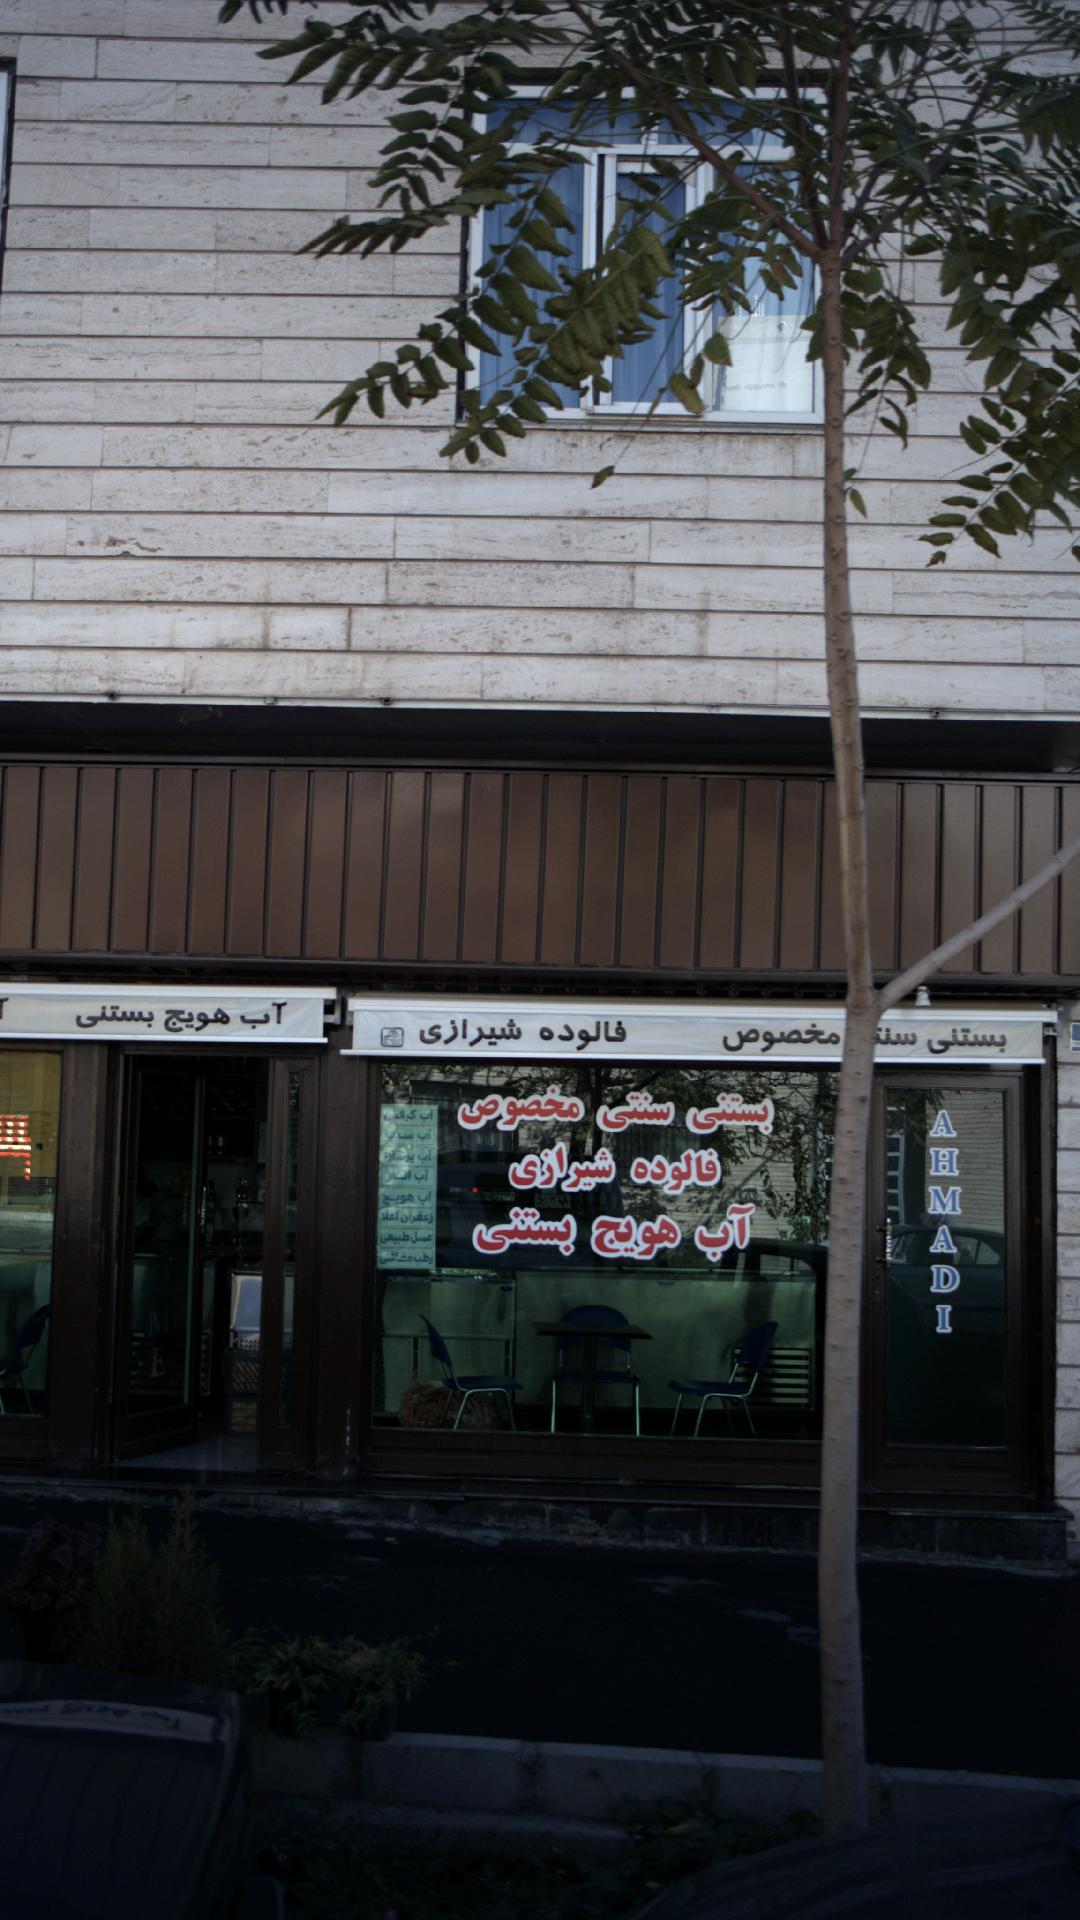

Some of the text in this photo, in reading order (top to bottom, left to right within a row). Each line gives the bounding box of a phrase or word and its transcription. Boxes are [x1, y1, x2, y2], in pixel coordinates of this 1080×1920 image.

[75, 1002, 288, 1032] آب هویج بستنی
[419, 1019, 627, 1051] فالوده شیرازی
[722, 1023, 1008, 1054] بستنی سنت مخصوص
[420, 1109, 433, 1122] آب
[459, 1086, 773, 1134] بستنی سنتی مخصوص
[414, 1169, 428, 1183] آب
[510, 1143, 721, 1194] فالوده شیرازی
[382, 1191, 432, 1206] آب هویج
[401, 1210, 433, 1224] زعفران
[474, 1203, 754, 1261] آب هویج بستنی
[928, 1109, 961, 1334] AHMADI
[411, 1231, 432, 1244] عسل
